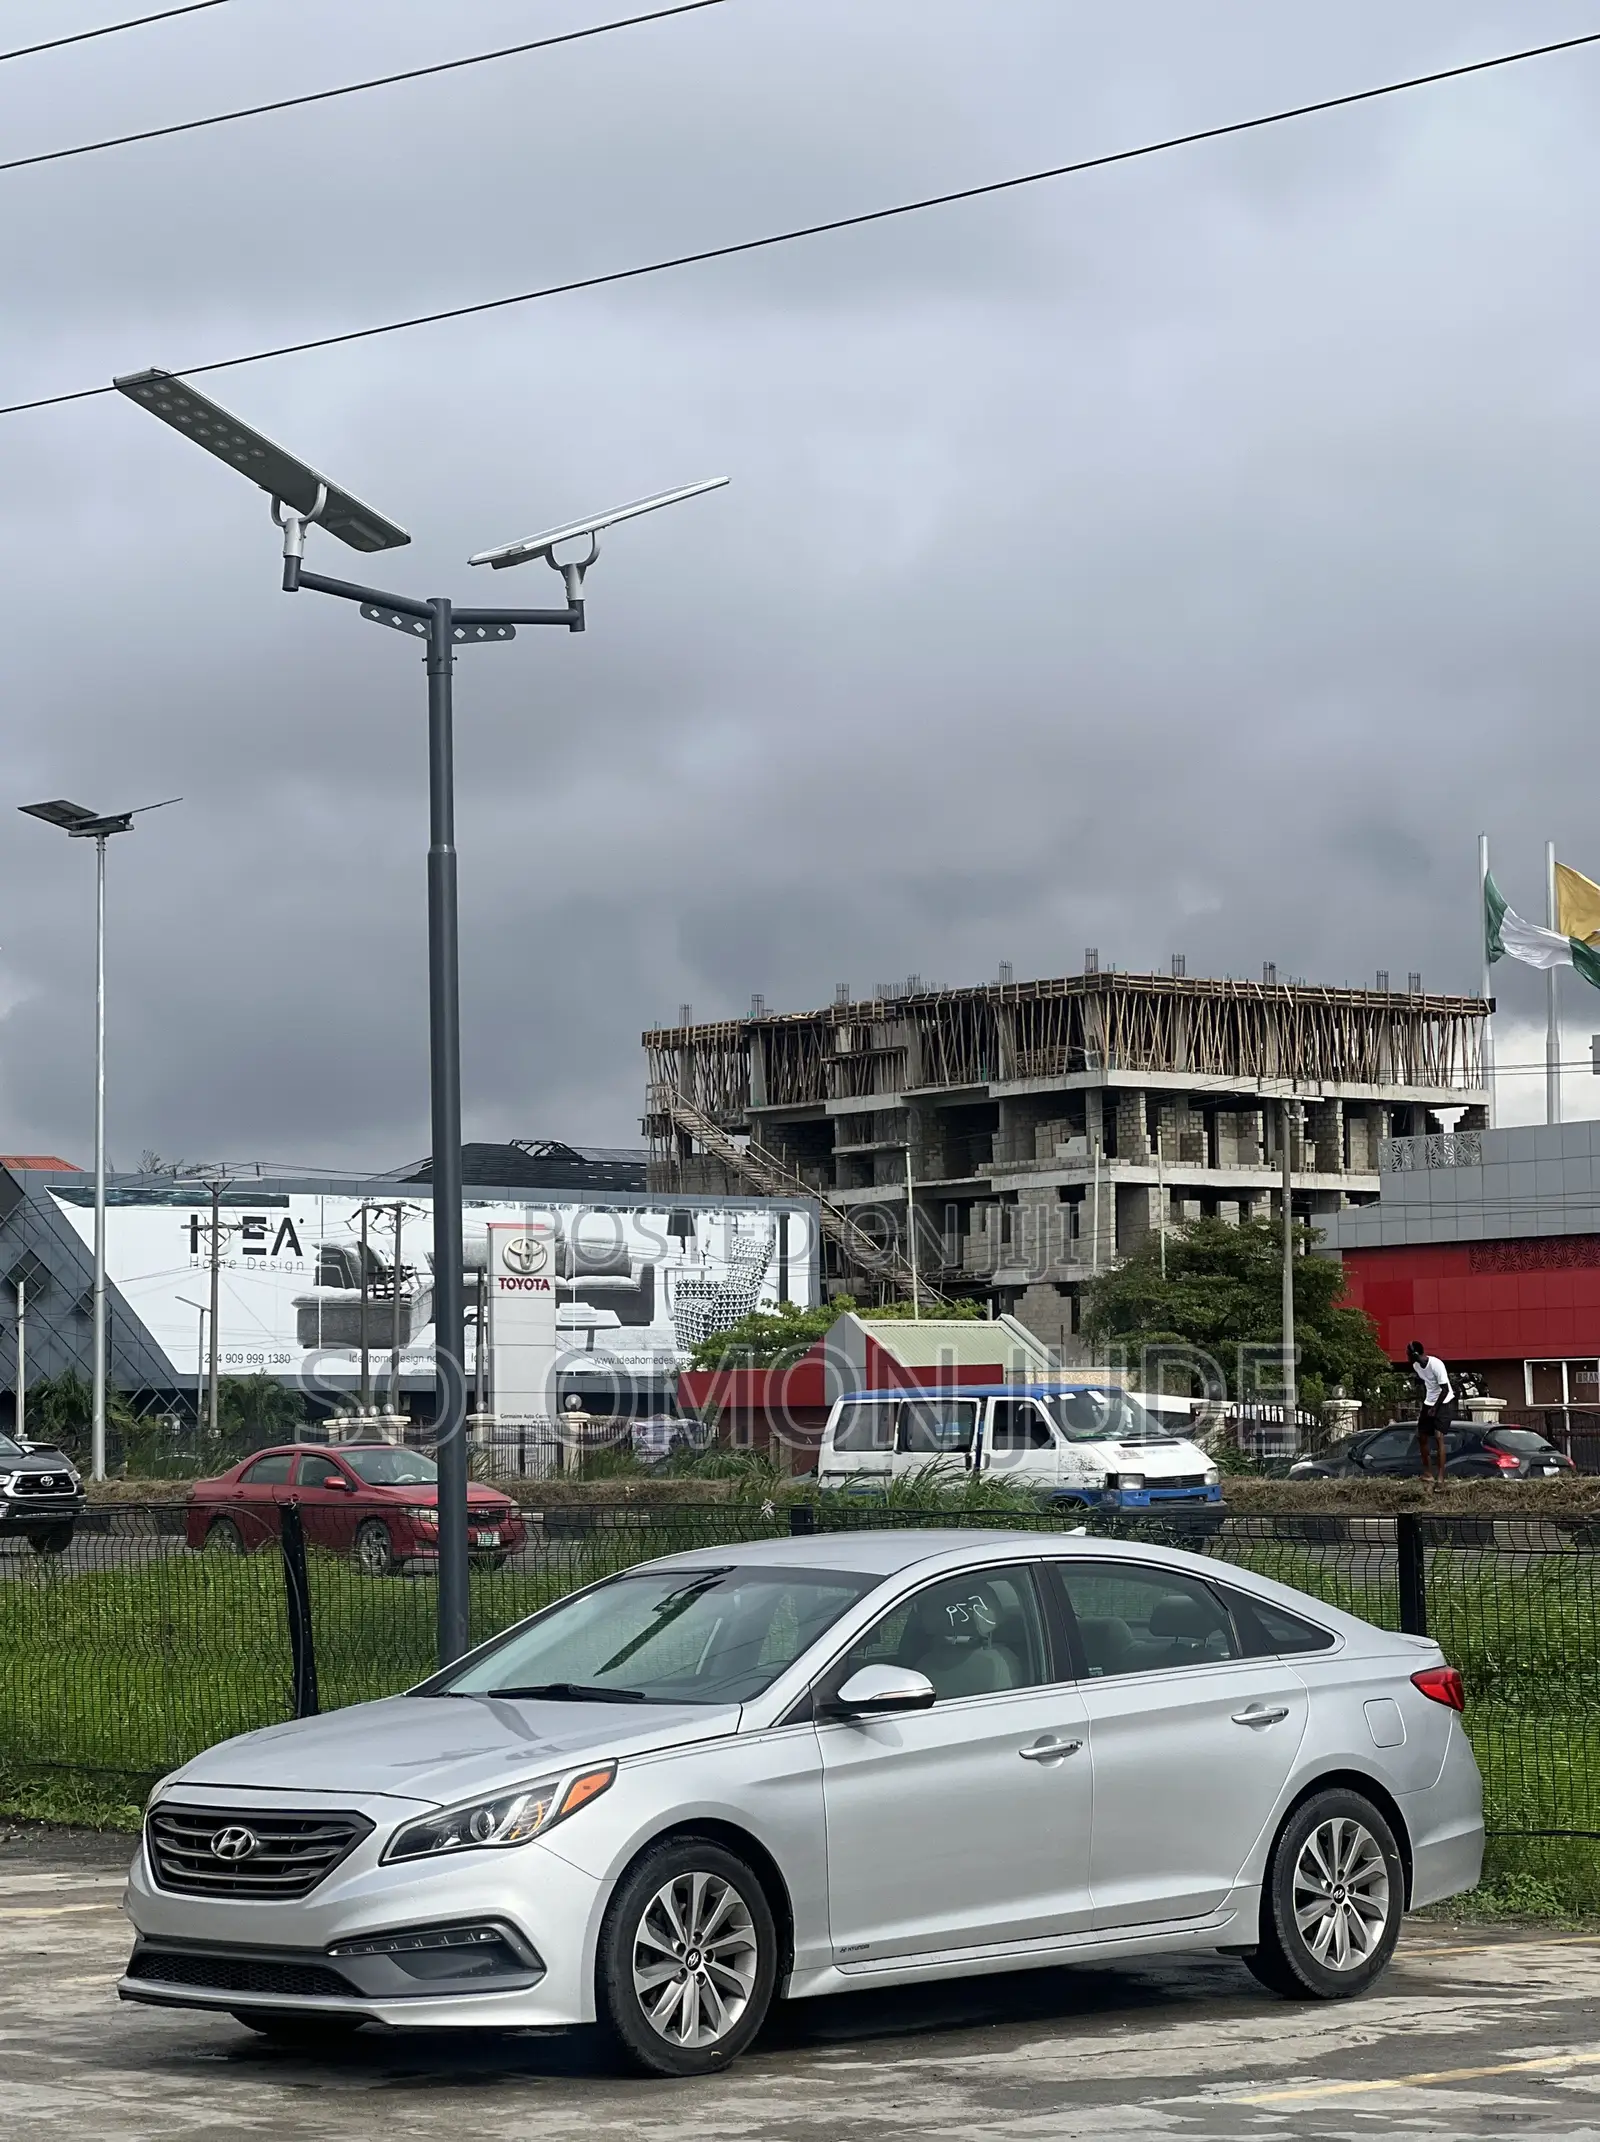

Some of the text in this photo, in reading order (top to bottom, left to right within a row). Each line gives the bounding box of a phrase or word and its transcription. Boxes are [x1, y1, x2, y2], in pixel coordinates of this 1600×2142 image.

[247, 1257, 304, 1274] Design
[498, 1277, 551, 1291] TOYOTA
[225, 1353, 243, 1364] 909
[246, 1353, 264, 1364] 999
[268, 1353, 291, 1364] 1380
